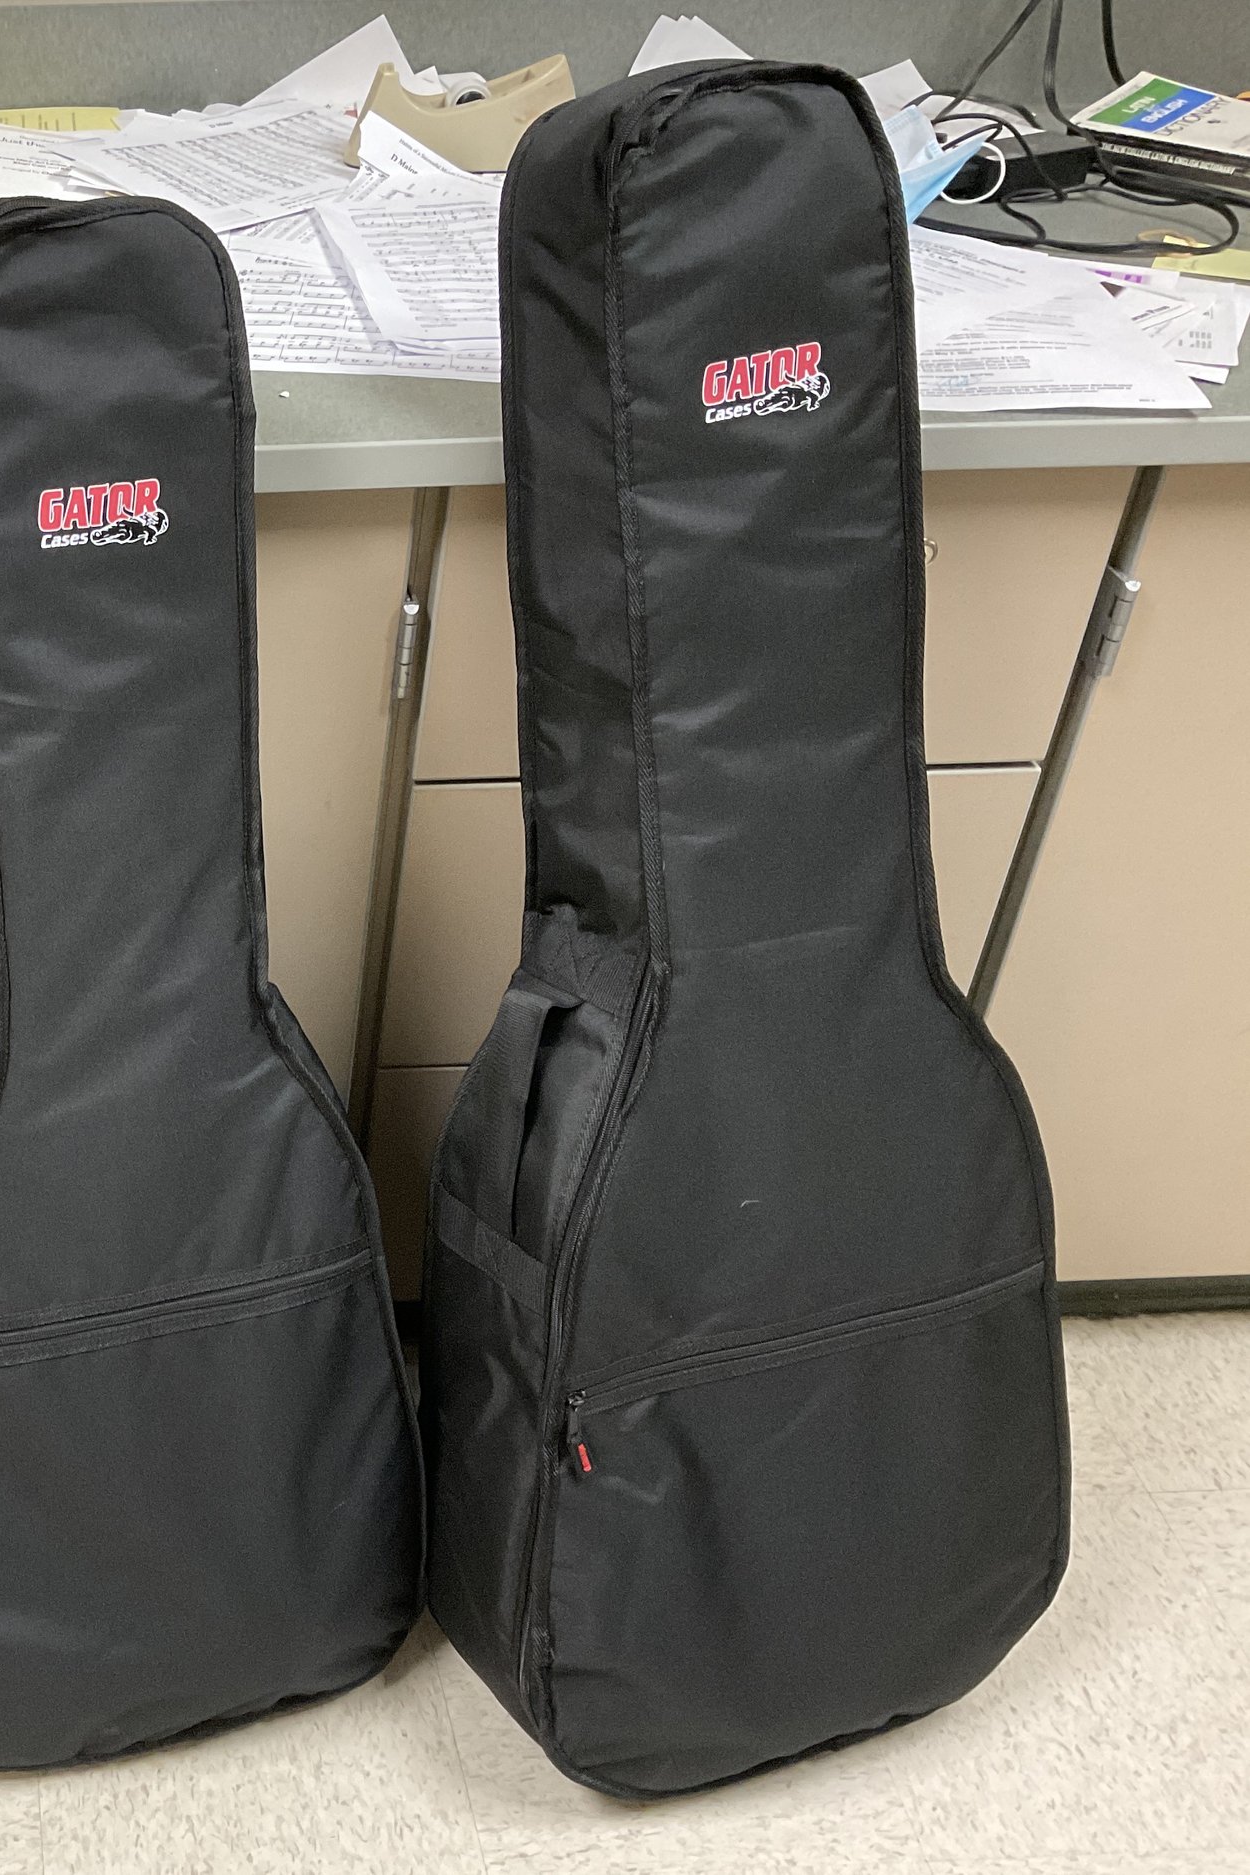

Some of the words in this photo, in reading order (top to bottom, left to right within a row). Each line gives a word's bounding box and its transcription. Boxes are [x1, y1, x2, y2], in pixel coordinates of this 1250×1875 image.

[1121, 96, 1156, 113] LATIN
[1140, 98, 1188, 124] ENGLISH
[702, 341, 822, 407] GATOR
[705, 402, 752, 424] Cases
[38, 478, 161, 533] GATOR
[40, 532, 89, 549] Cases
